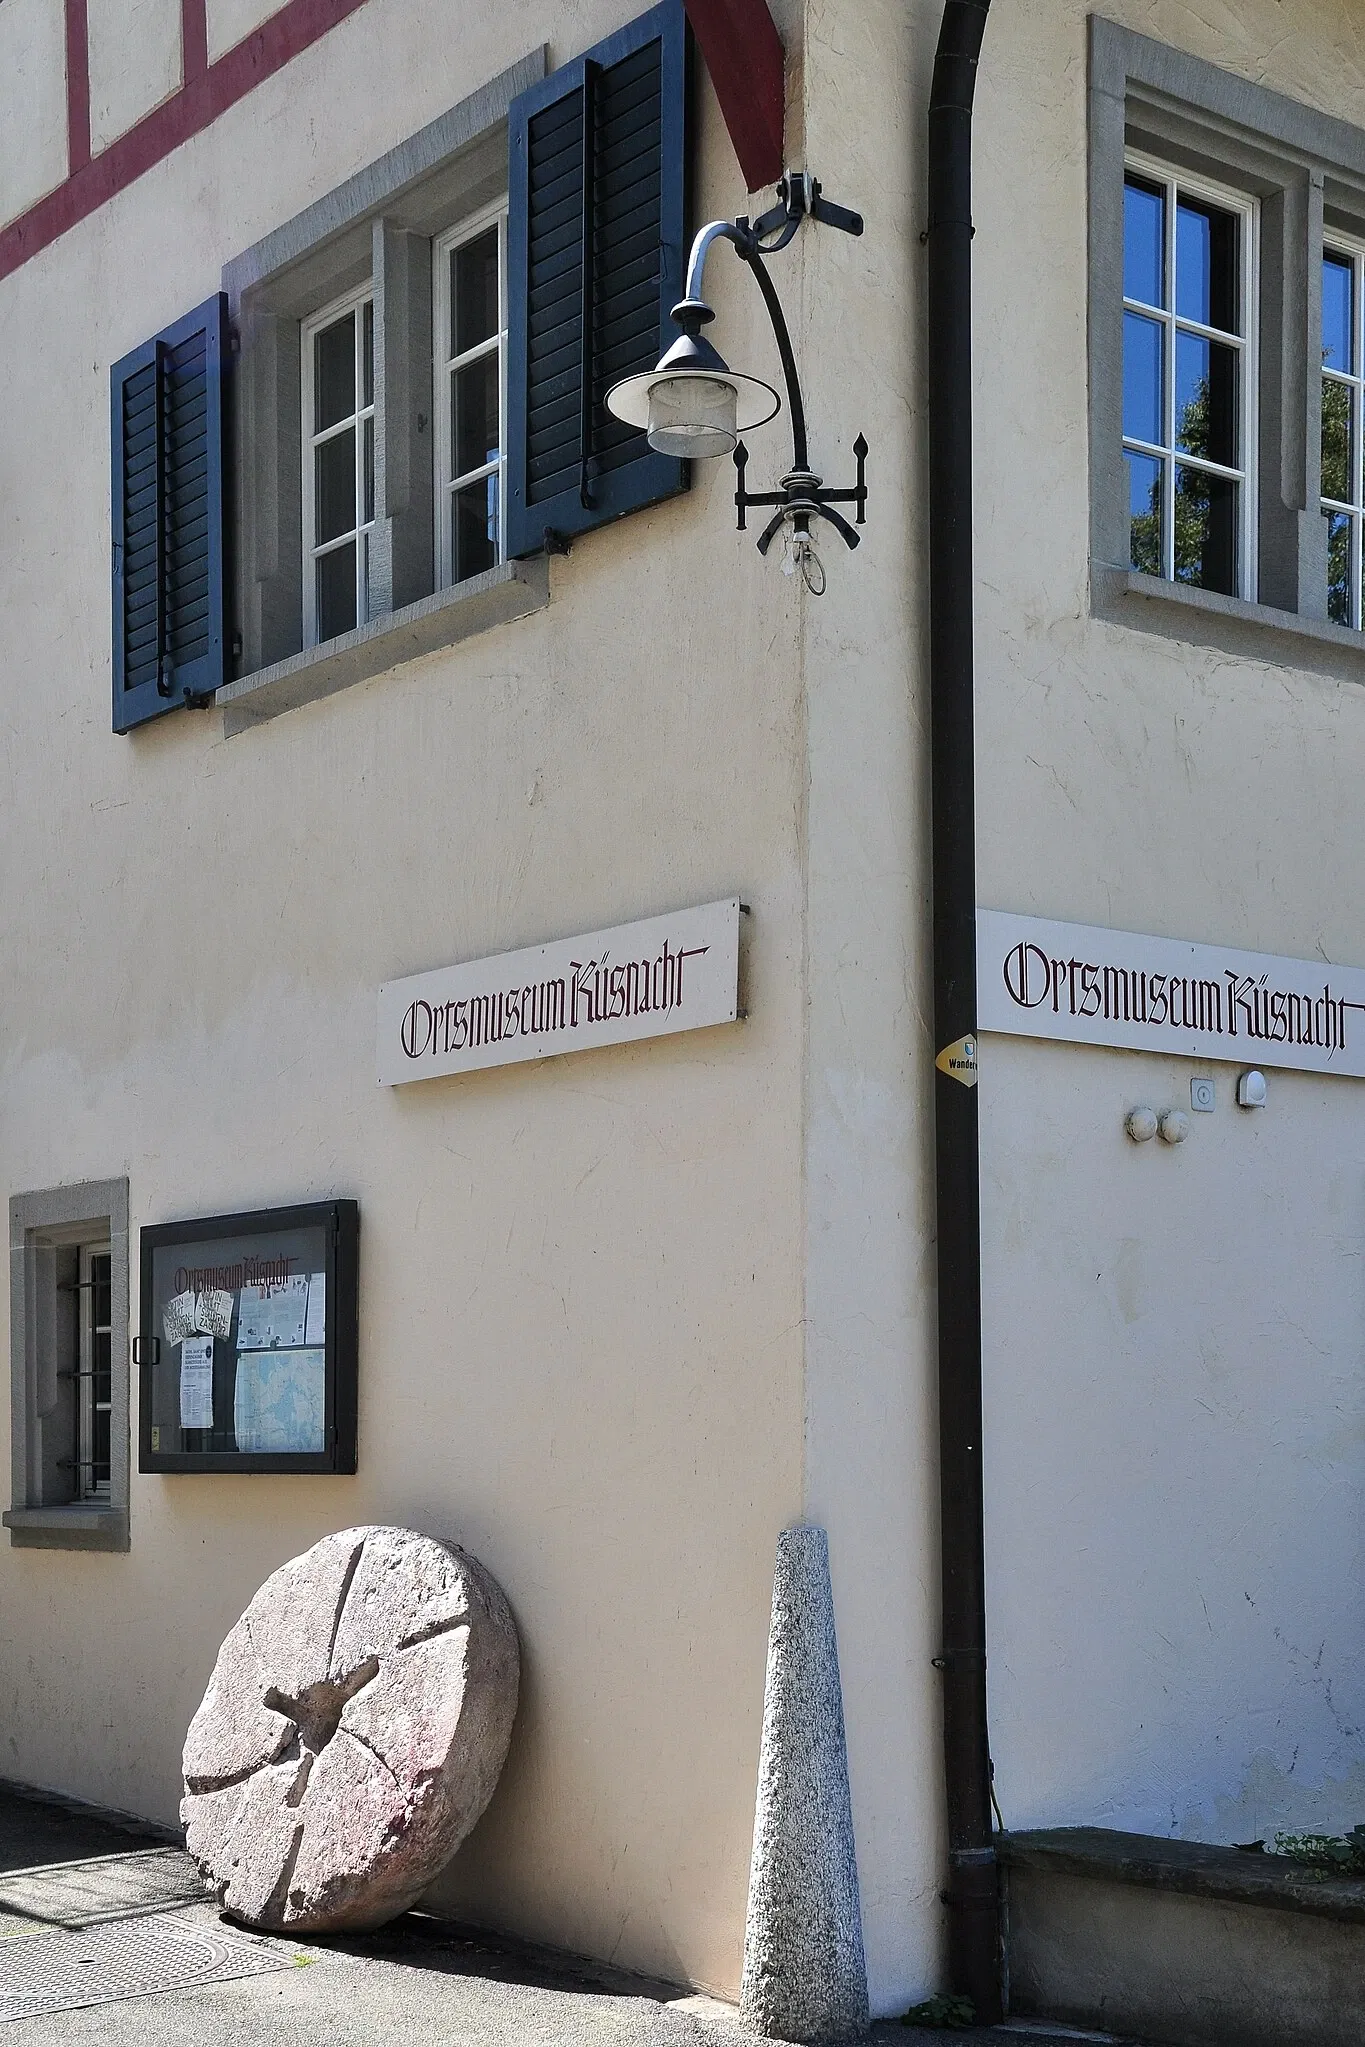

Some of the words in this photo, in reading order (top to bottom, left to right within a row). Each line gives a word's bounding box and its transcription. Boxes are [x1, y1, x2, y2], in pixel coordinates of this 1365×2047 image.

[400, 977, 566, 1059] Ortsmuseum
[569, 938, 711, 1028] Küsnacht
[1002, 941, 1223, 1035] Ortsmuseum
[1223, 968, 1365, 1061] Küsnacht
[174, 1263, 243, 1295] Ortsmuseum
